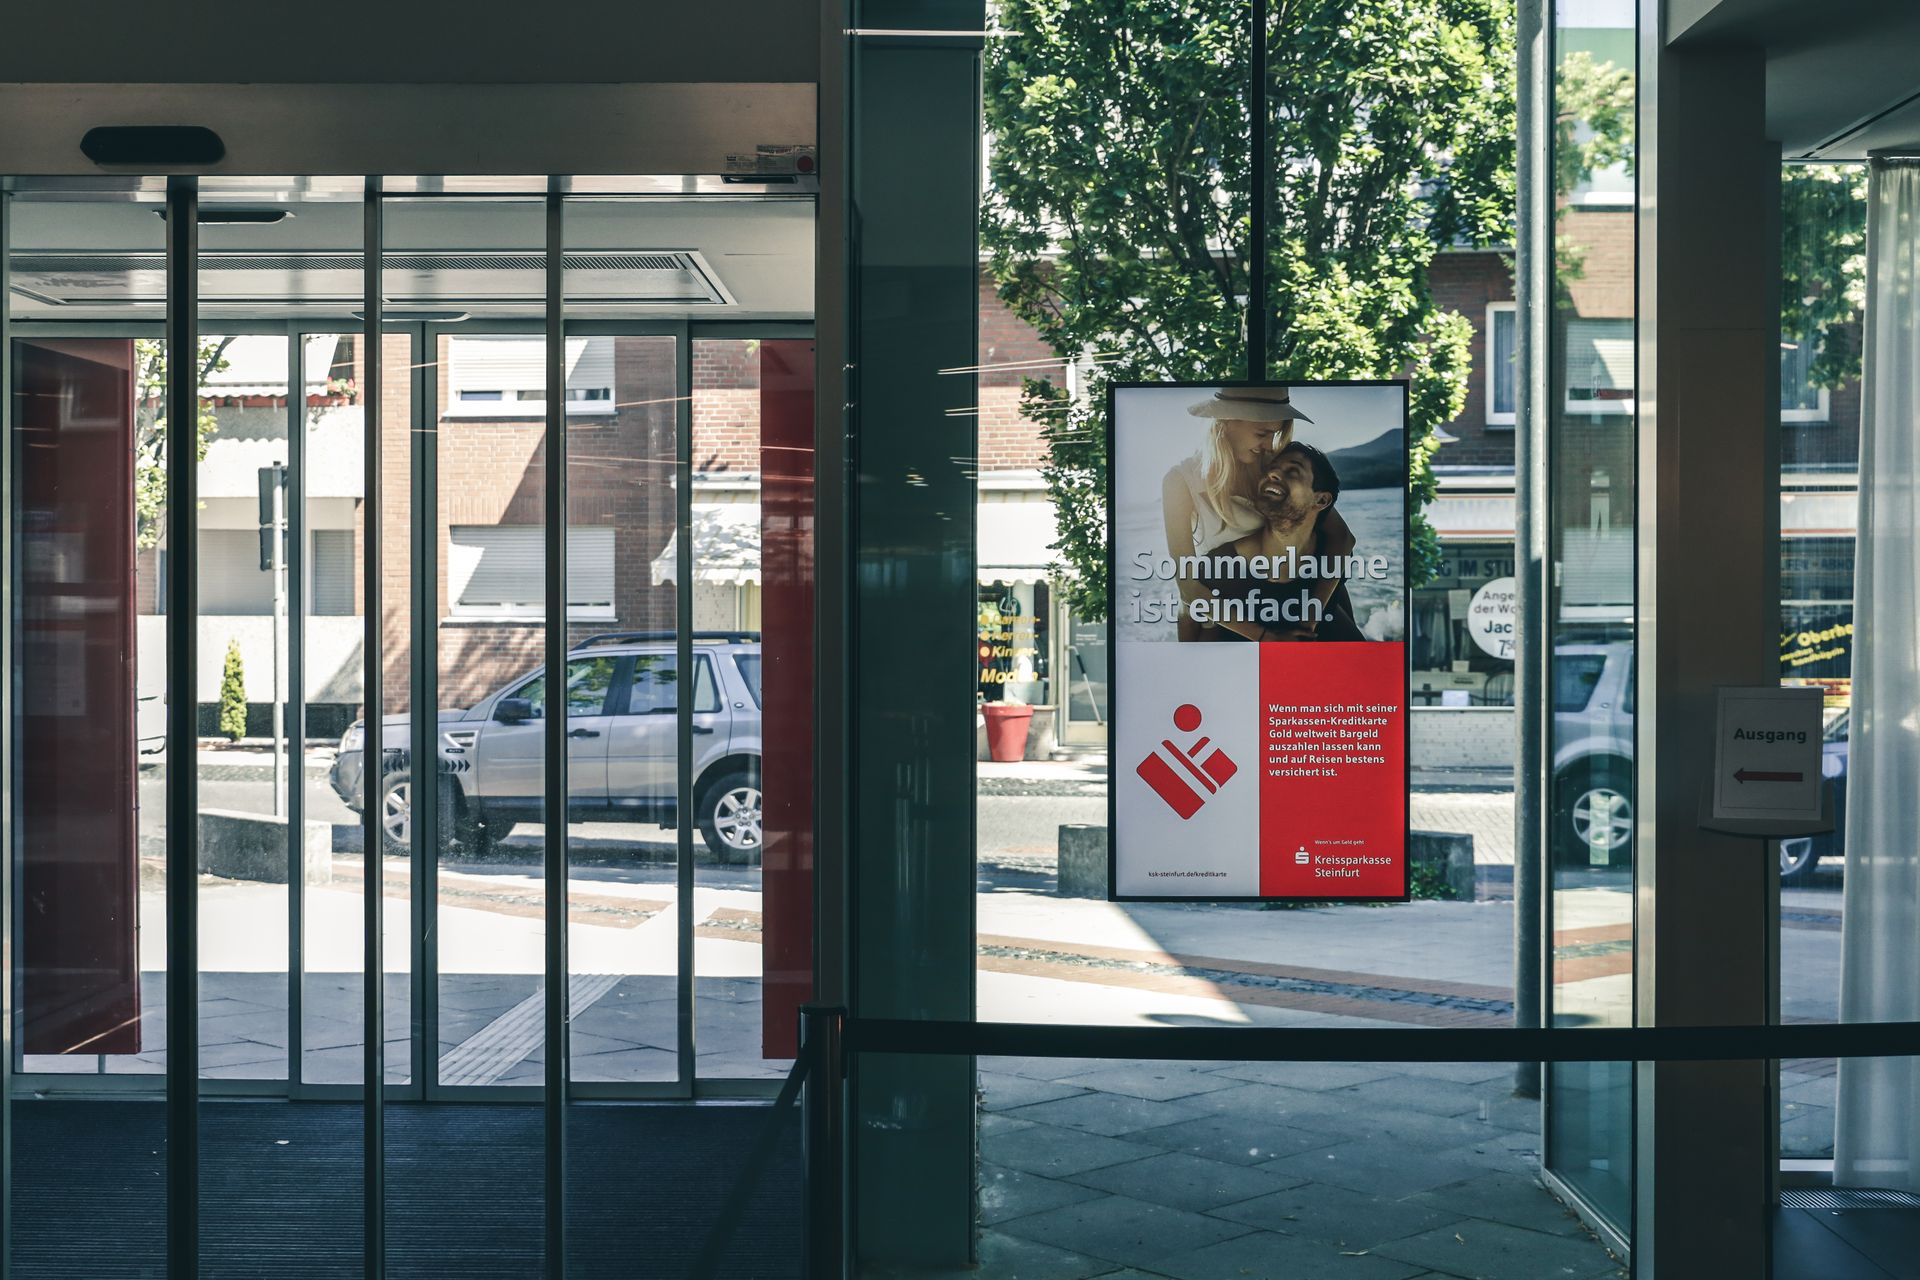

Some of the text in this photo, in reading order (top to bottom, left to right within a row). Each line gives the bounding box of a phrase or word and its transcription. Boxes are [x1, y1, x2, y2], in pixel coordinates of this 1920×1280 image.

[1130, 546, 1389, 581] Sommerlaune
[1458, 559, 1478, 577] IM
[1130, 588, 1335, 623] ist einfach.
[1473, 604, 1494, 614] der
[1483, 620, 1512, 634] Jac
[980, 668, 1039, 684] Modn
[1269, 703, 1398, 713] Wenn man sich mit seiner
[1269, 716, 1388, 727] Sparkassen-Kreditkarte
[1269, 729, 1379, 741] Gold weltweit Bargeld
[1733, 727, 1807, 744] Ausgang
[1269, 741, 1382, 751] auszahlen lassen kann
[1269, 754, 1385, 764] und auf Reisen bestens
[1269, 767, 1338, 777] versichert ist.
[1315, 855, 1392, 867] Kreissparkasse
[1148, 871, 1228, 879] ksk-steinfurt.de/kreditkarte
[1315, 867, 1360, 878] Steinfurt
